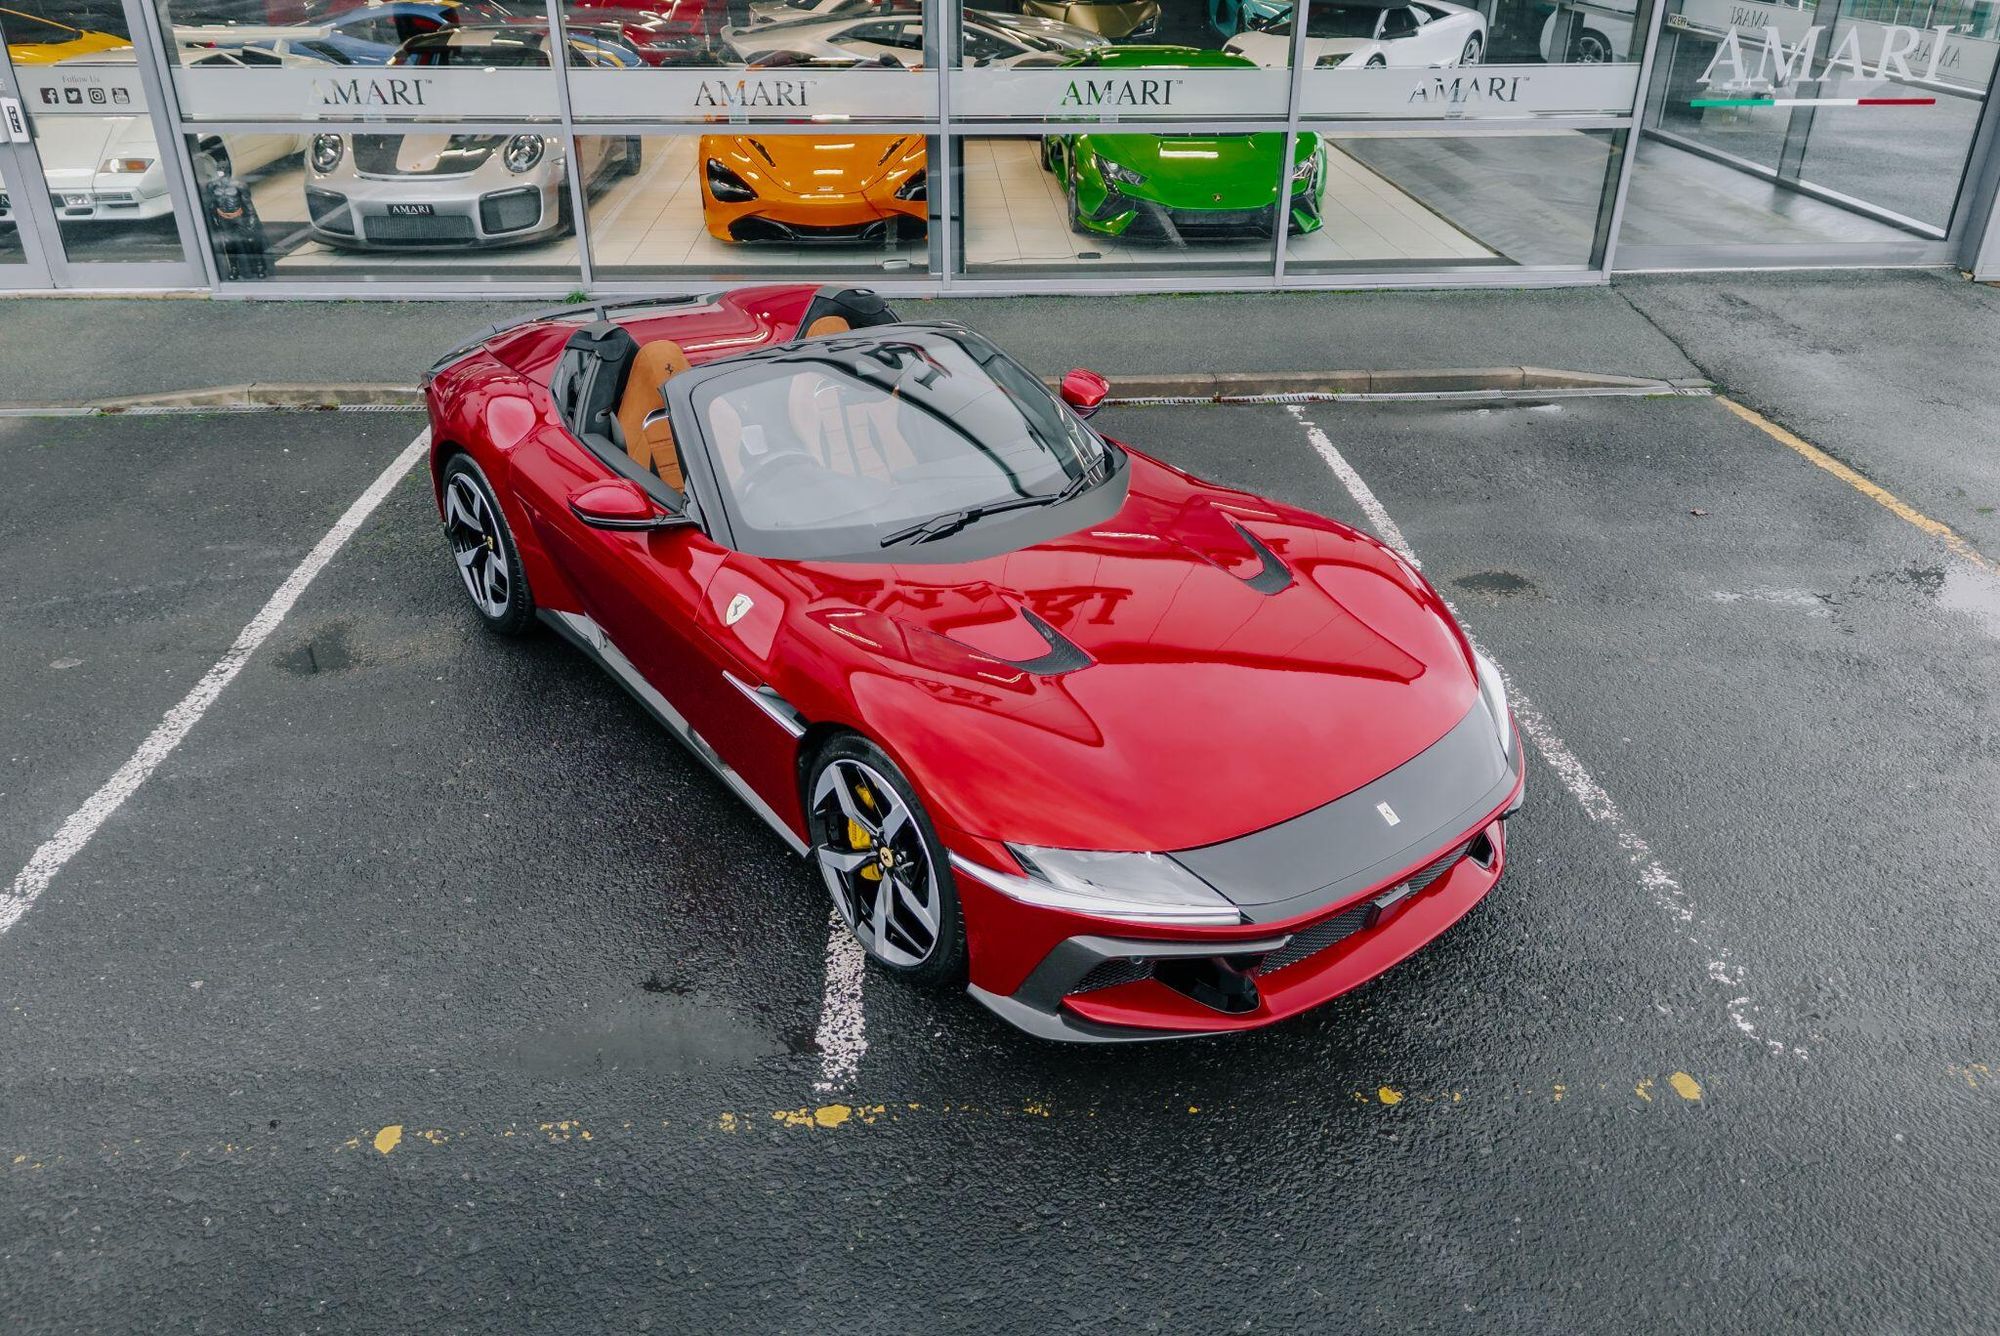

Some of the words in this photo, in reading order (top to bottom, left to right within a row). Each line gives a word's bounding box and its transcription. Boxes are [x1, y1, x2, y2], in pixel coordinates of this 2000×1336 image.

[1697, 25, 1955, 83] AMARI
[694, 80, 808, 106] AMARI
[1061, 80, 1174, 105] AMARI
[1408, 76, 1520, 103] AMARI
[392, 205, 431, 214] AMARI
